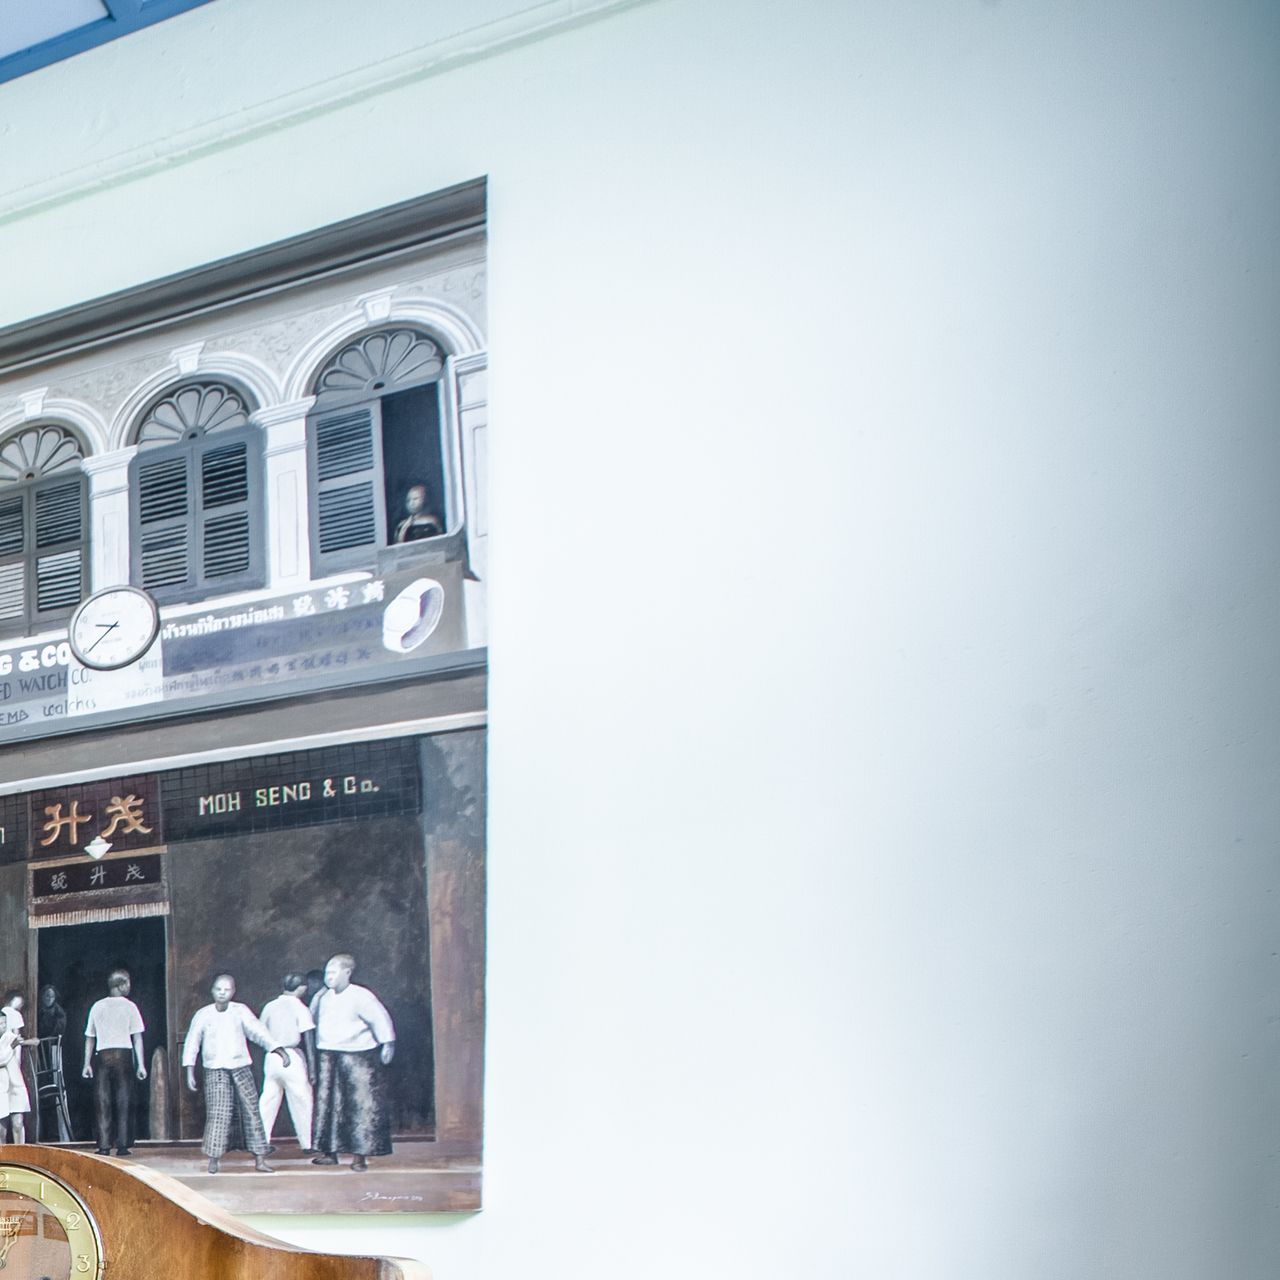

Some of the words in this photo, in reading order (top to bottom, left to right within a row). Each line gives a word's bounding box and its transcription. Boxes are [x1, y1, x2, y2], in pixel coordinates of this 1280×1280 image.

[19, 671, 68, 700] WATCH
[199, 791, 240, 816] MOH
[256, 782, 311, 807] SENG
[323, 779, 336, 798] &
[40, 1182, 45, 1200] 1
[66, 1211, 80, 1231] 2
[77, 1254, 90, 1272] 3
